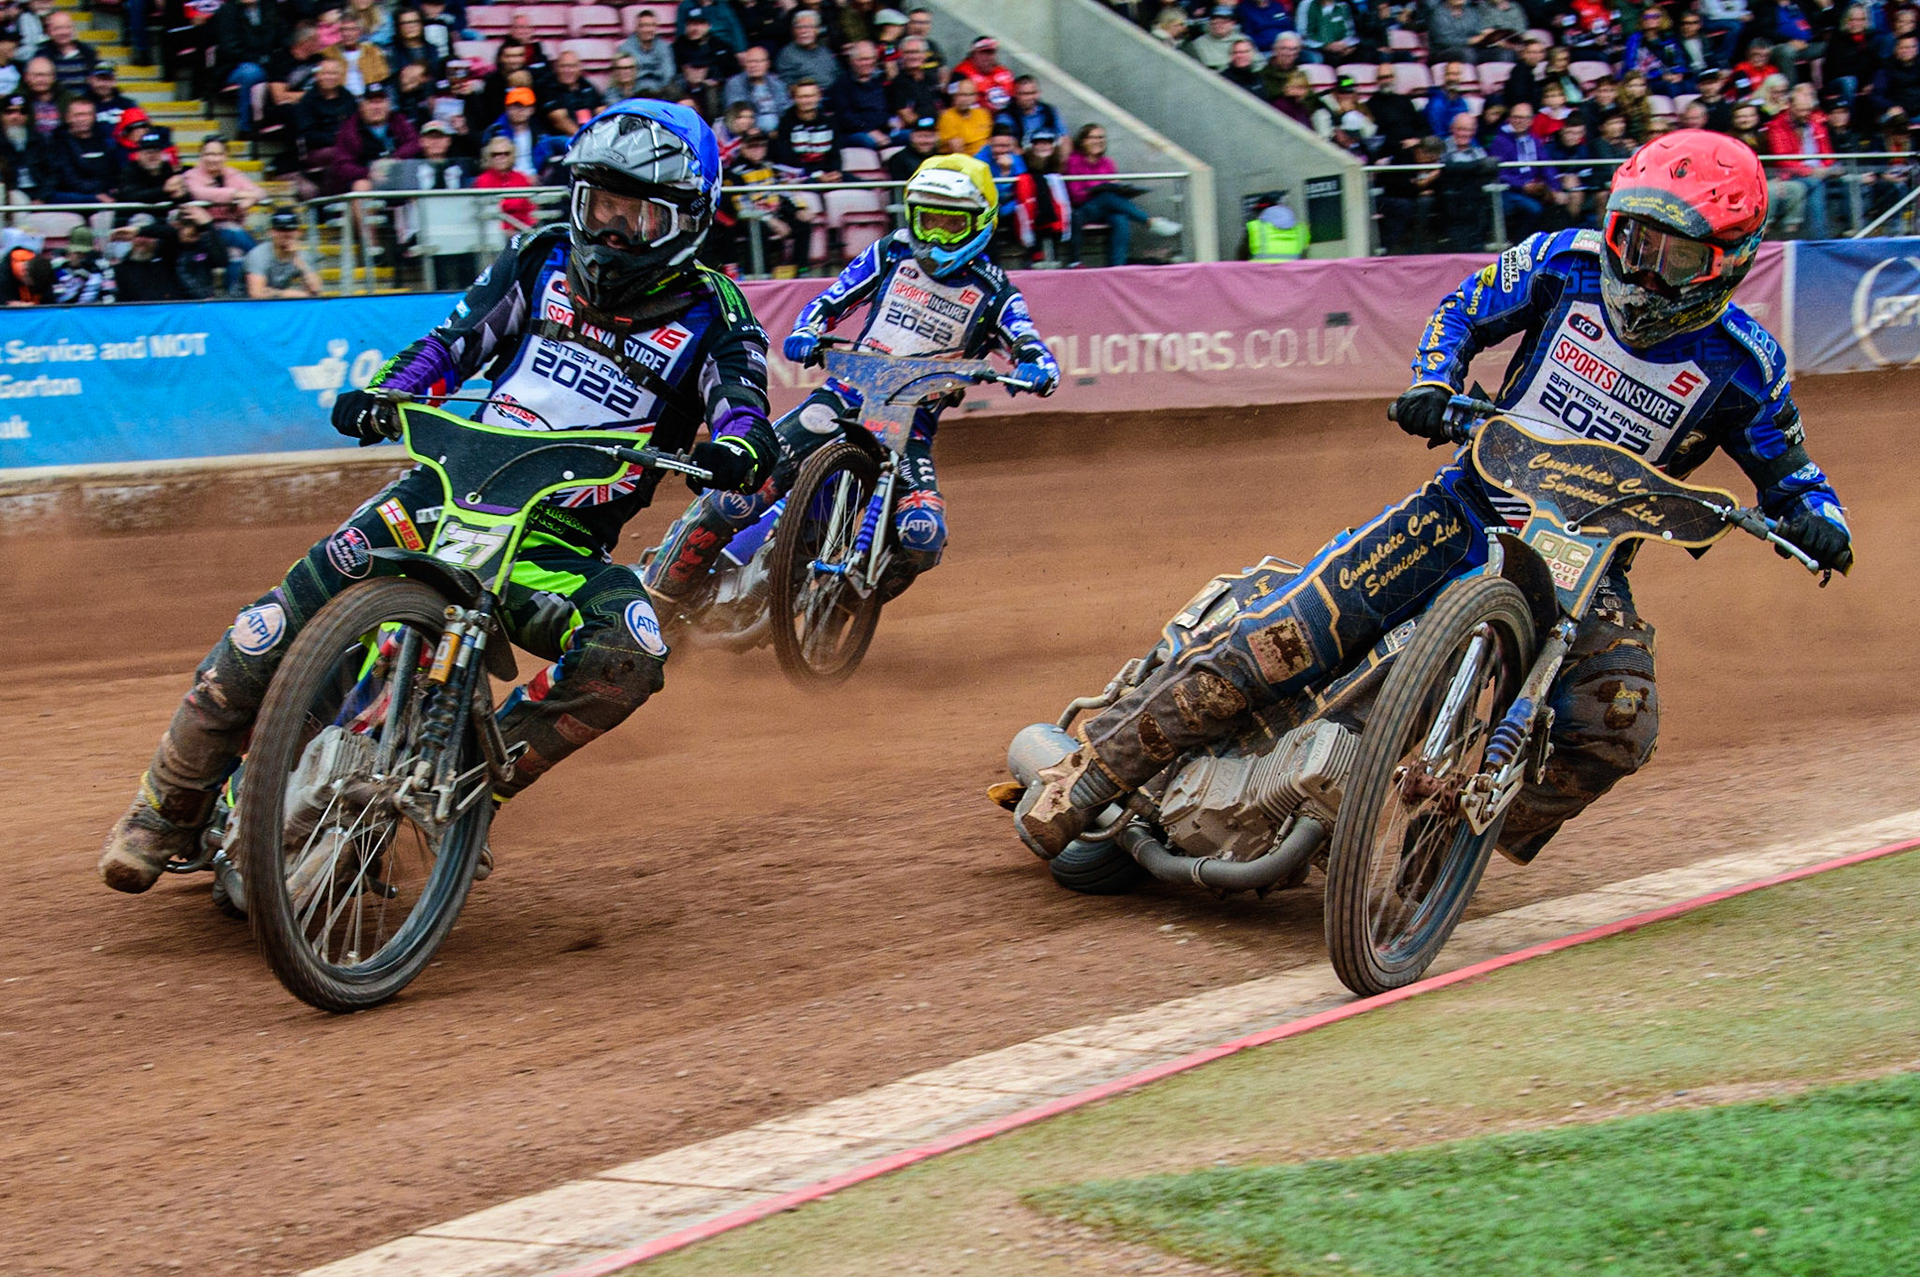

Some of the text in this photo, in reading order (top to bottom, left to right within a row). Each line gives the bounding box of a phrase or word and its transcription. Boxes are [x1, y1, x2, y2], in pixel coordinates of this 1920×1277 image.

[1503, 251, 1511, 291] TRUCKS
[1510, 251, 1518, 280] DRIVE
[893, 280, 968, 323] SPORTS INSURE
[885, 307, 953, 347] 2022
[1575, 317, 1598, 337] SCB
[4, 332, 210, 365] Service and MOT
[1045, 324, 1361, 377] OLICITORS.CO.UK
[531, 348, 639, 418] 2022
[1555, 341, 1617, 390] SPORTS
[1613, 380, 1680, 426] INSURE
[1667, 370, 1701, 397] 5
[1549, 371, 1655, 442] BRITISH FINAL
[1528, 452, 1614, 486] Complete
[725, 491, 751, 515] ATPI
[1622, 502, 1666, 527] Ltd
[907, 519, 933, 533] ATPI
[1339, 510, 1440, 590] Complete Car
[1364, 517, 1462, 597] Services Ltd
[246, 612, 271, 644] ATPI
[637, 615, 660, 636] ATP
